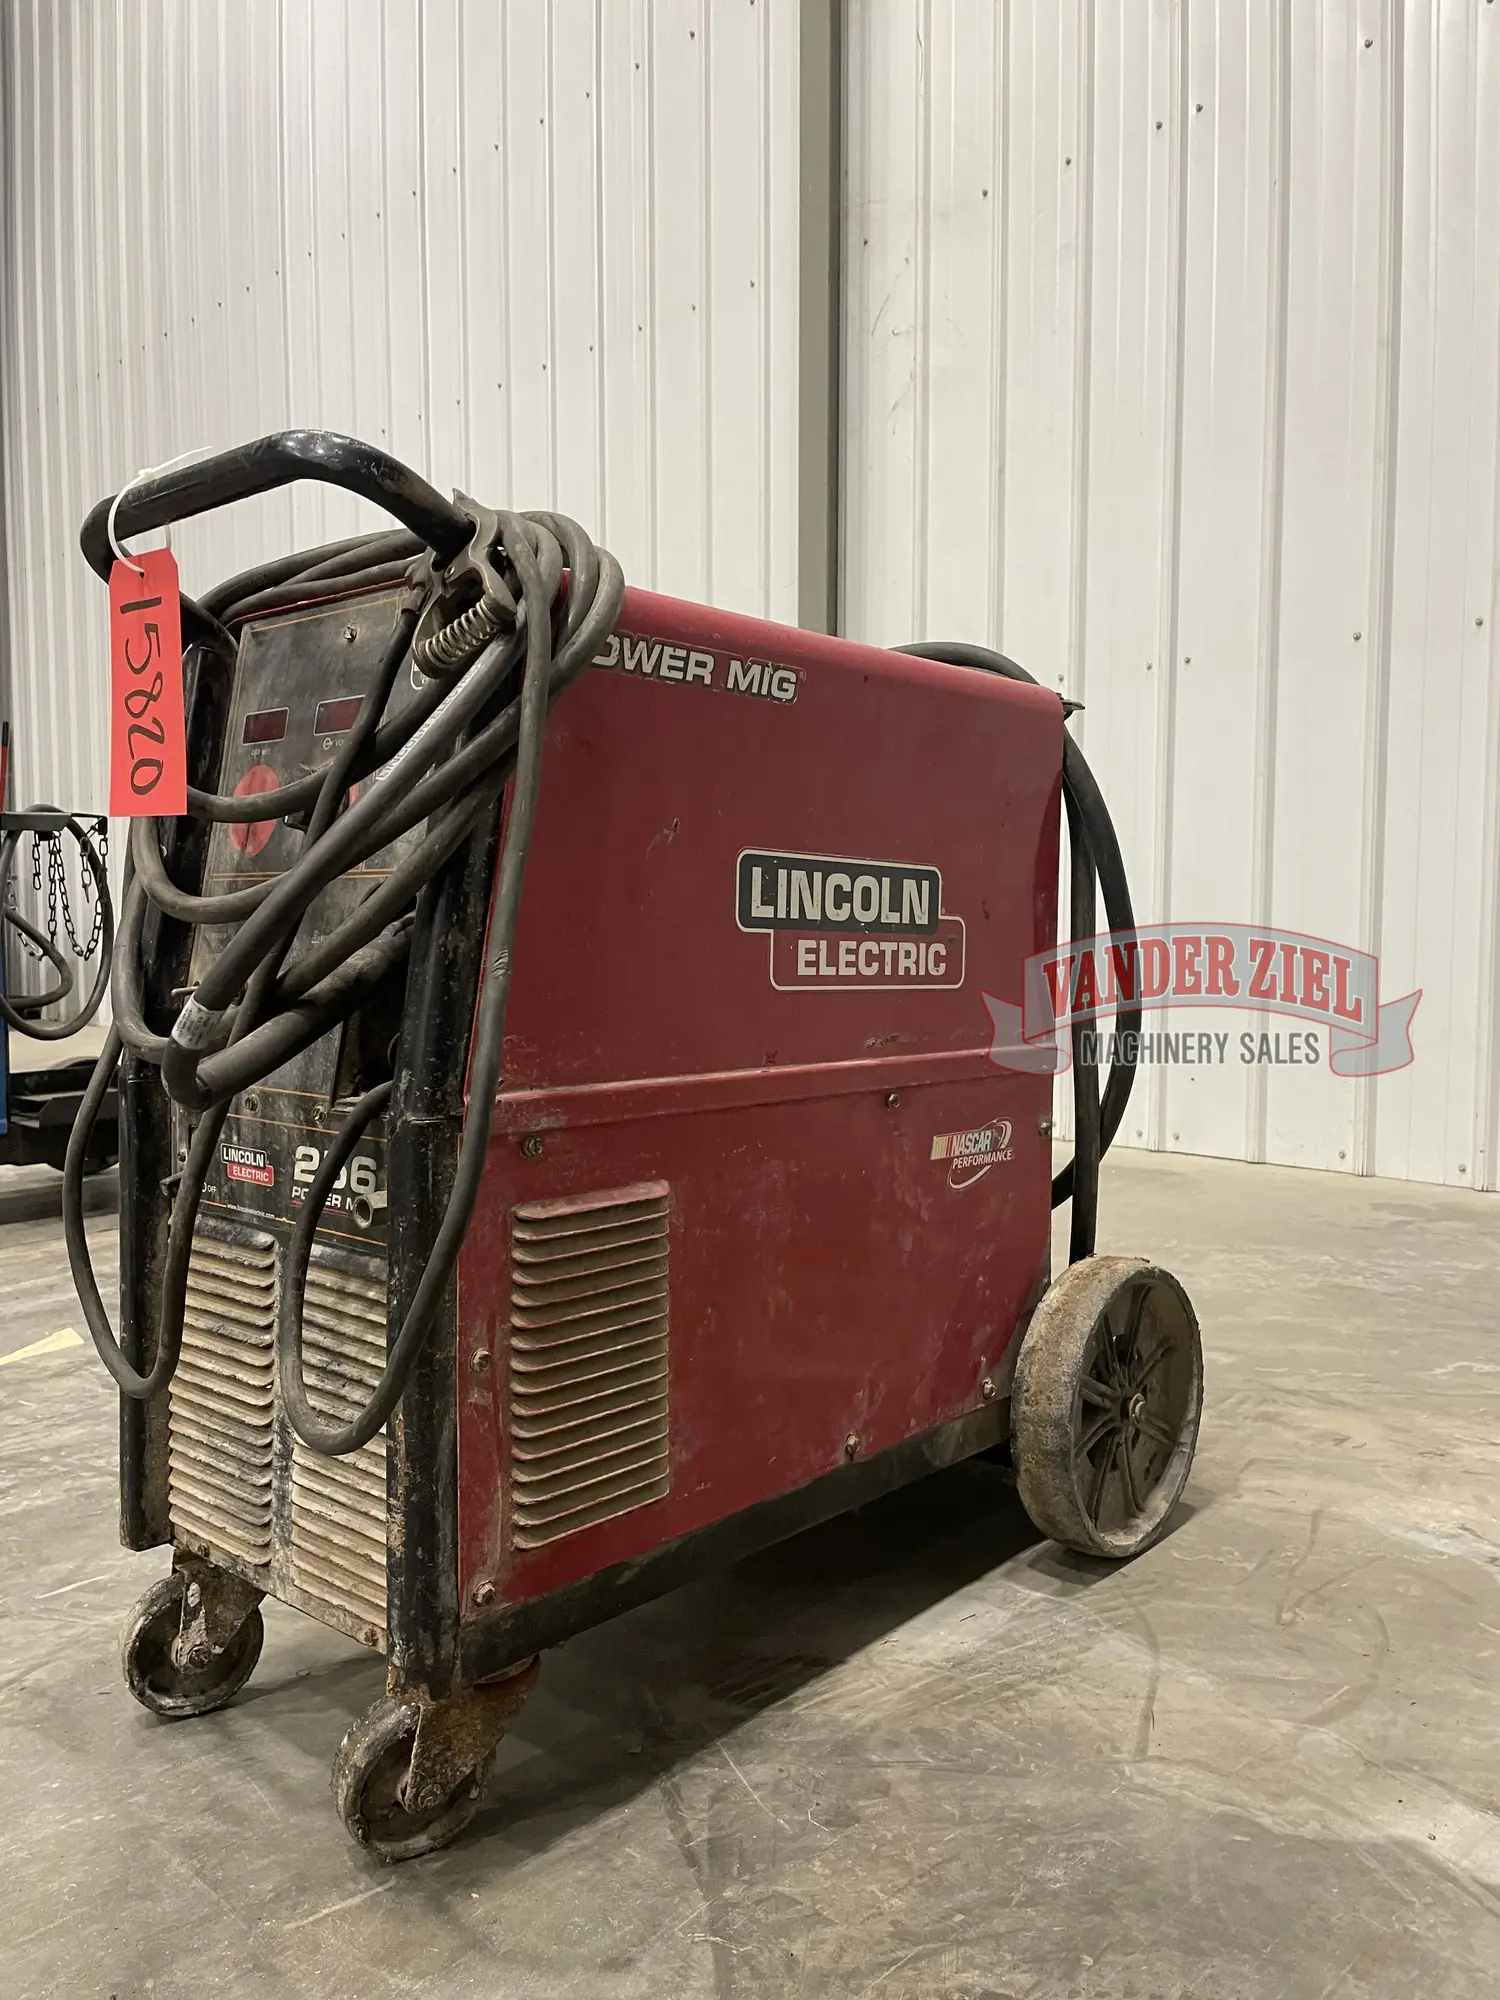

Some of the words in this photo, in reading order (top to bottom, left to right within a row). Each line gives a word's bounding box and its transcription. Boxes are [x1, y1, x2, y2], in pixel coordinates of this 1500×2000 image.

[591, 634, 714, 685] OWER
[726, 659, 797, 700] MIG
[120, 597, 165, 795] 15820
[751, 866, 930, 925] LINCOLN
[797, 939, 947, 976] ELECTRIC
[951, 1130, 992, 1156] NASCAR
[223, 1147, 264, 1167] LINCOLN
[952, 1149, 1013, 1170] PERFORMANCE
[232, 1166, 269, 1182] ELECTRIC
[207, 1184, 217, 1193] OFF
[291, 1185, 342, 1208] POER
